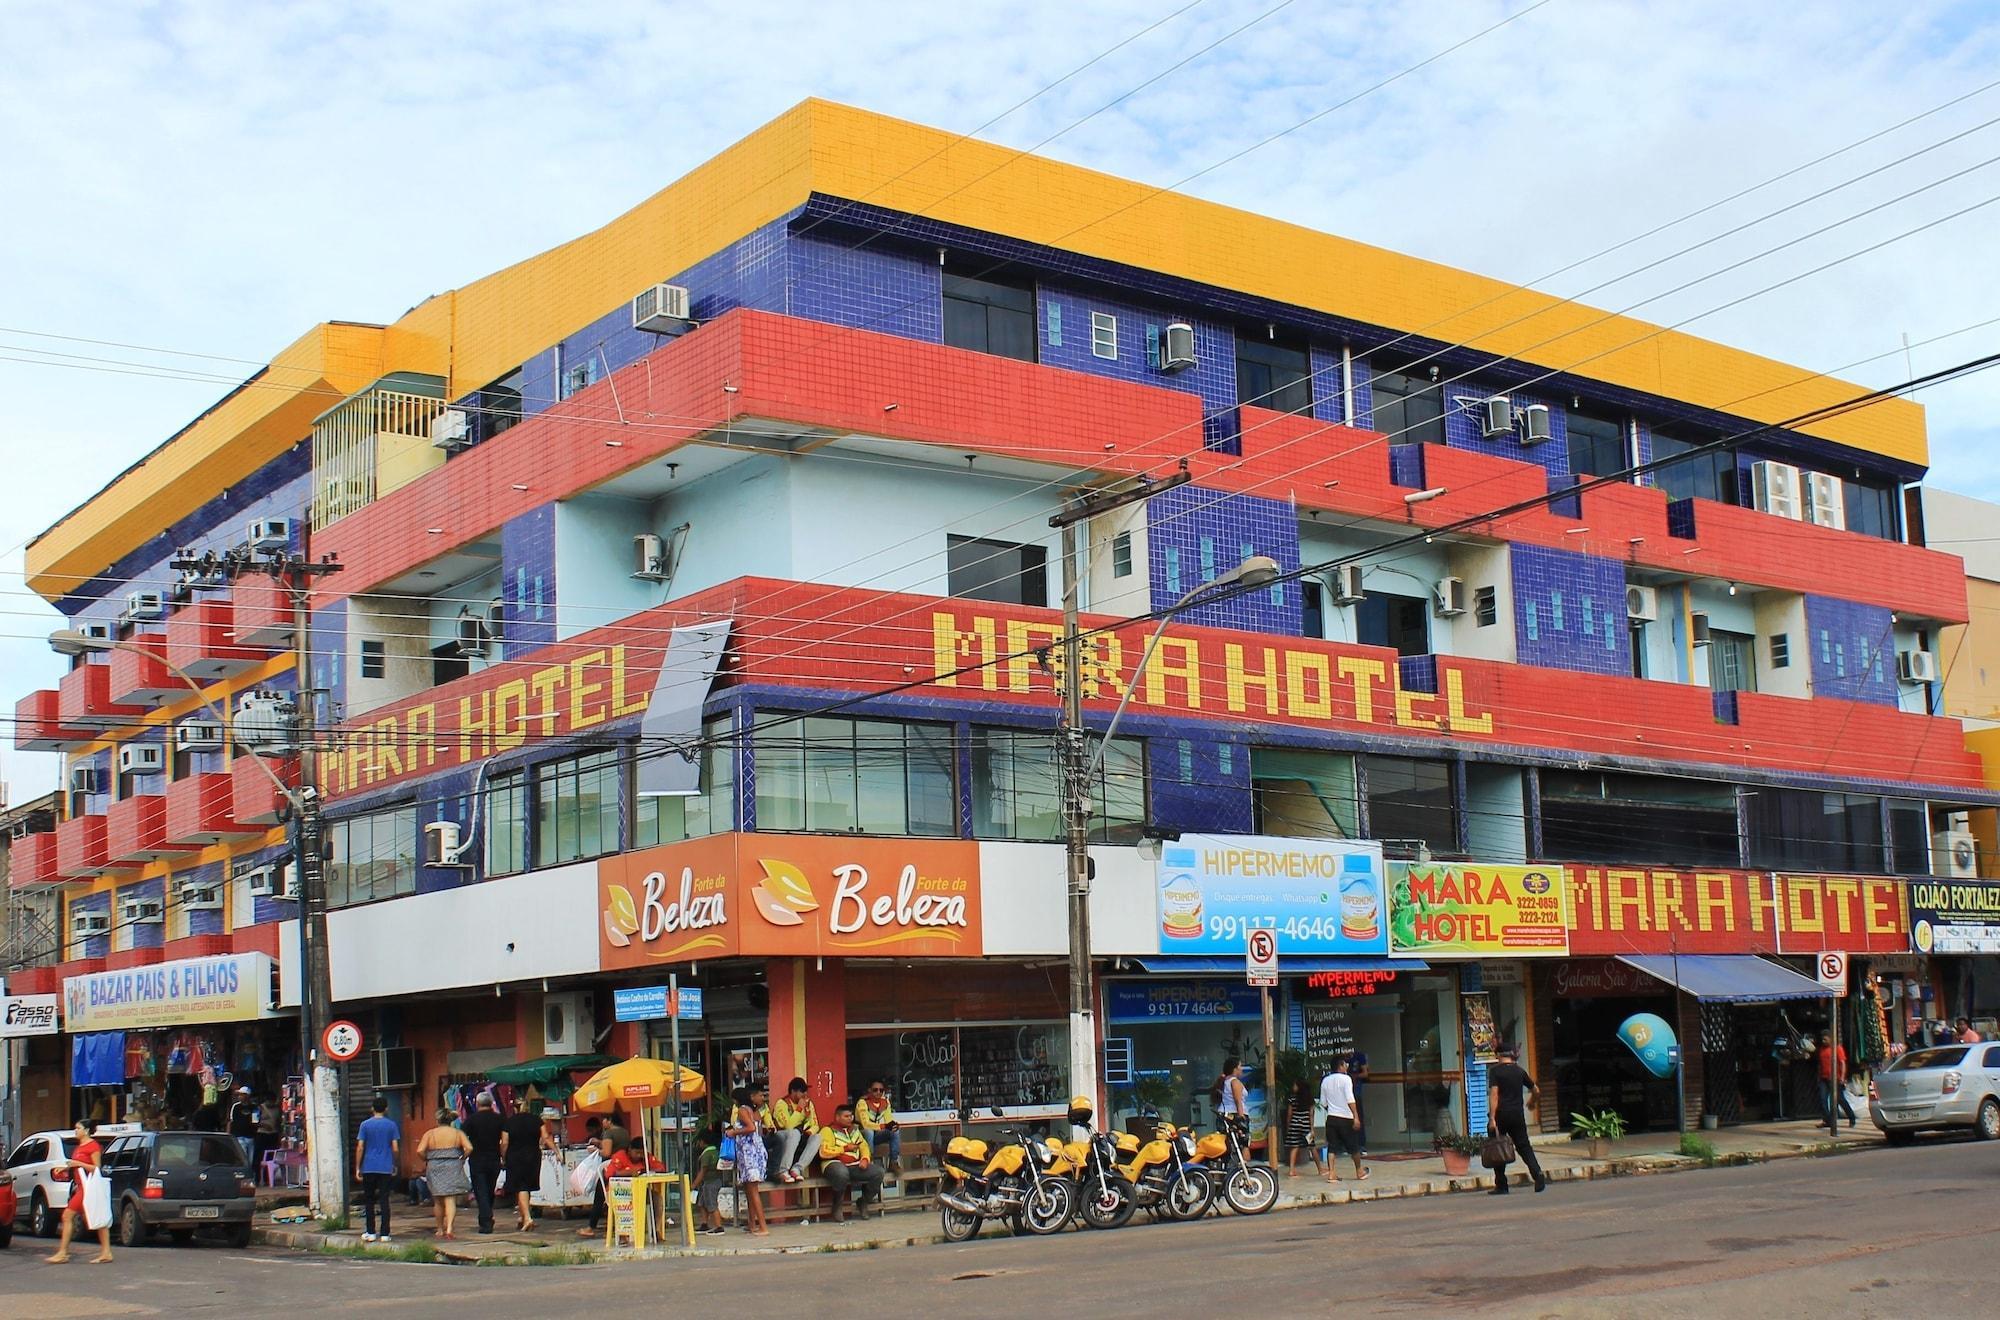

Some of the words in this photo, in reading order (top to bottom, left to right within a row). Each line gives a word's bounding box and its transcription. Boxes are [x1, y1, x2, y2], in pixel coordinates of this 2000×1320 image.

[932, 611, 1200, 709] MARA
[1224, 642, 1494, 735] HOTEL
[320, 704, 436, 798] MARA
[459, 643, 650, 764] HOTEL
[1203, 848, 1336, 879] HIPERMEMO
[694, 877, 714, 894] Forte
[715, 875, 726, 889] da
[829, 863, 968, 935] Beleza
[916, 876, 949, 891] Forte
[951, 877, 967, 891] da
[1408, 870, 1513, 906] MARA
[641, 866, 728, 944] Beleza
[1516, 896, 1559, 910] 3222-0859
[1562, 868, 1735, 932] MARA
[1414, 913, 1499, 942] HOTEL
[1519, 910, 1559, 924] 3223-2124
[90, 974, 132, 1006] BAZAR
[135, 971, 166, 1001] PAIS
[170, 969, 180, 998] &
[184, 962, 239, 996] FILHOS
[1148, 987, 1227, 1002] HIPERMEMO
[1308, 970, 1396, 988] HYPERMEMO
[1329, 984, 1375, 998] 10:46:46
[1556, 962, 1601, 996] Galeria
[900, 1031, 958, 1068] Salão
